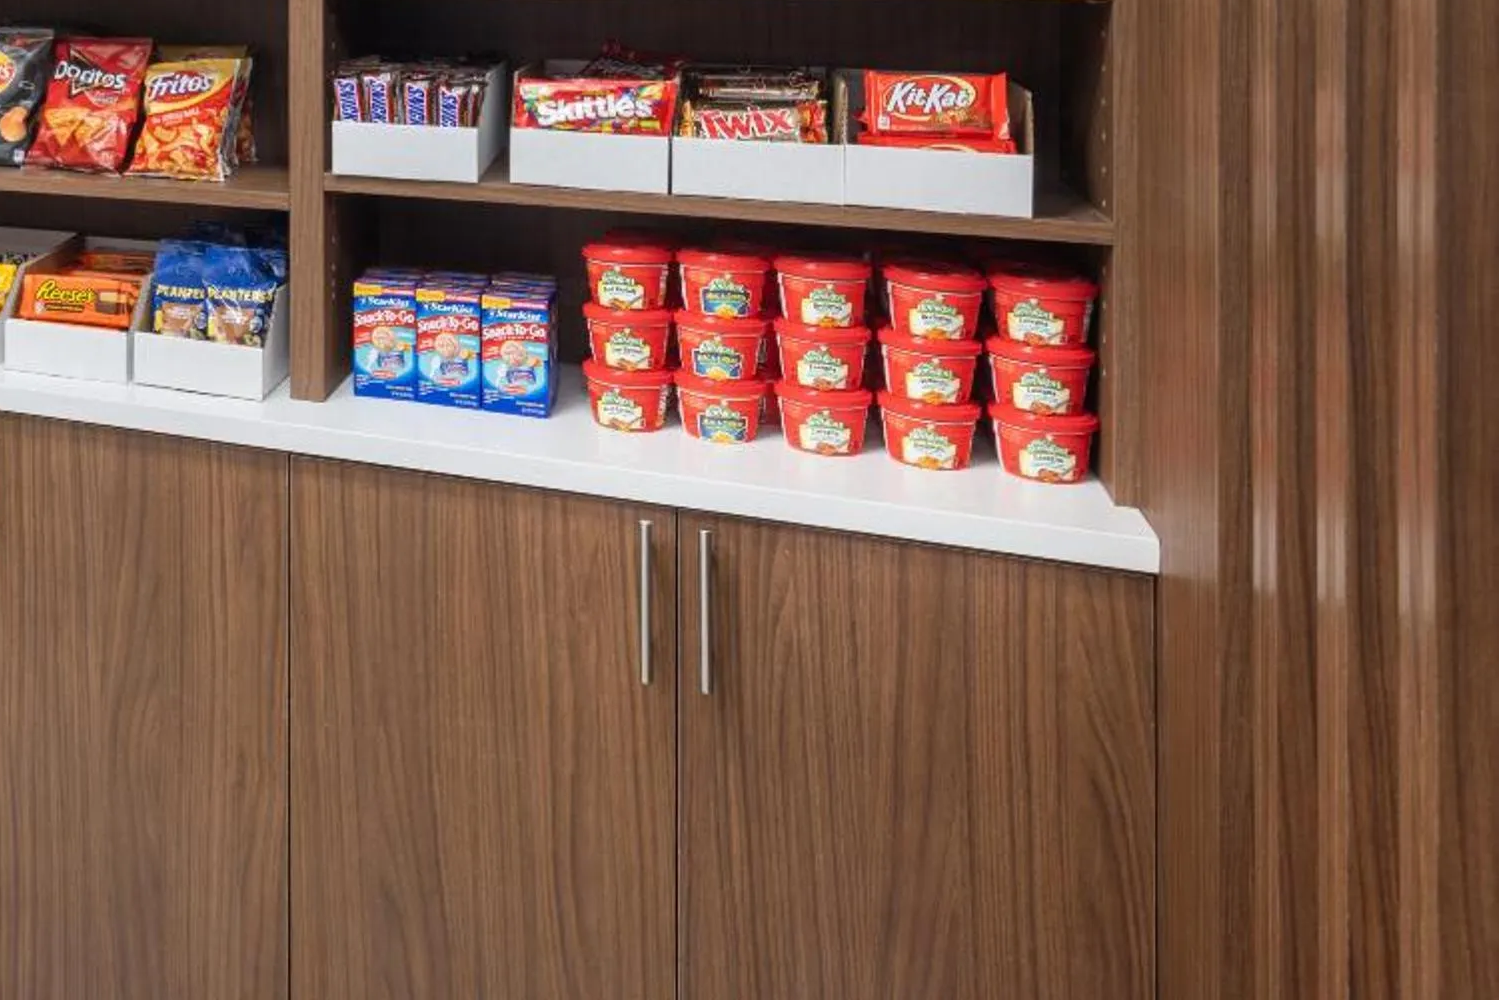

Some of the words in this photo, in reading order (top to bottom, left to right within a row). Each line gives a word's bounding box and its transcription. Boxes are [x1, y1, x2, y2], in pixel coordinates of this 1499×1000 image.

[54, 60, 127, 90] Doritos
[149, 72, 215, 99] Fritos
[536, 93, 653, 126] Skittles
[34, 279, 96, 302] Reese's
